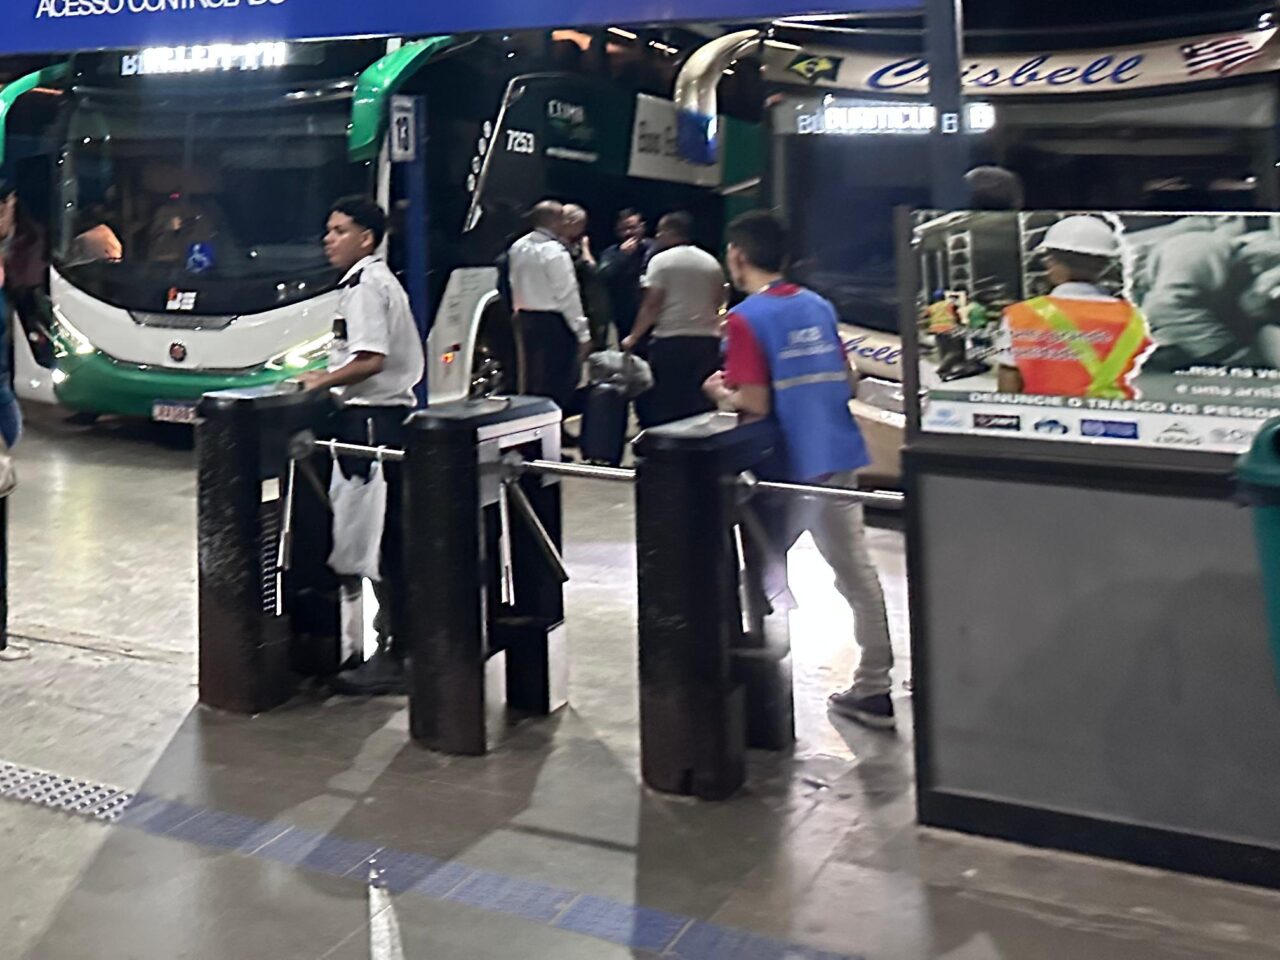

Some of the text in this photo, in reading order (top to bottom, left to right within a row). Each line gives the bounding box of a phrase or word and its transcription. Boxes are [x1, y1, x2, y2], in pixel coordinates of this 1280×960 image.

[869, 53, 1146, 90] Cisbell
[970, 391, 1063, 408] DENUNCIE
[1069, 395, 1082, 408] O
